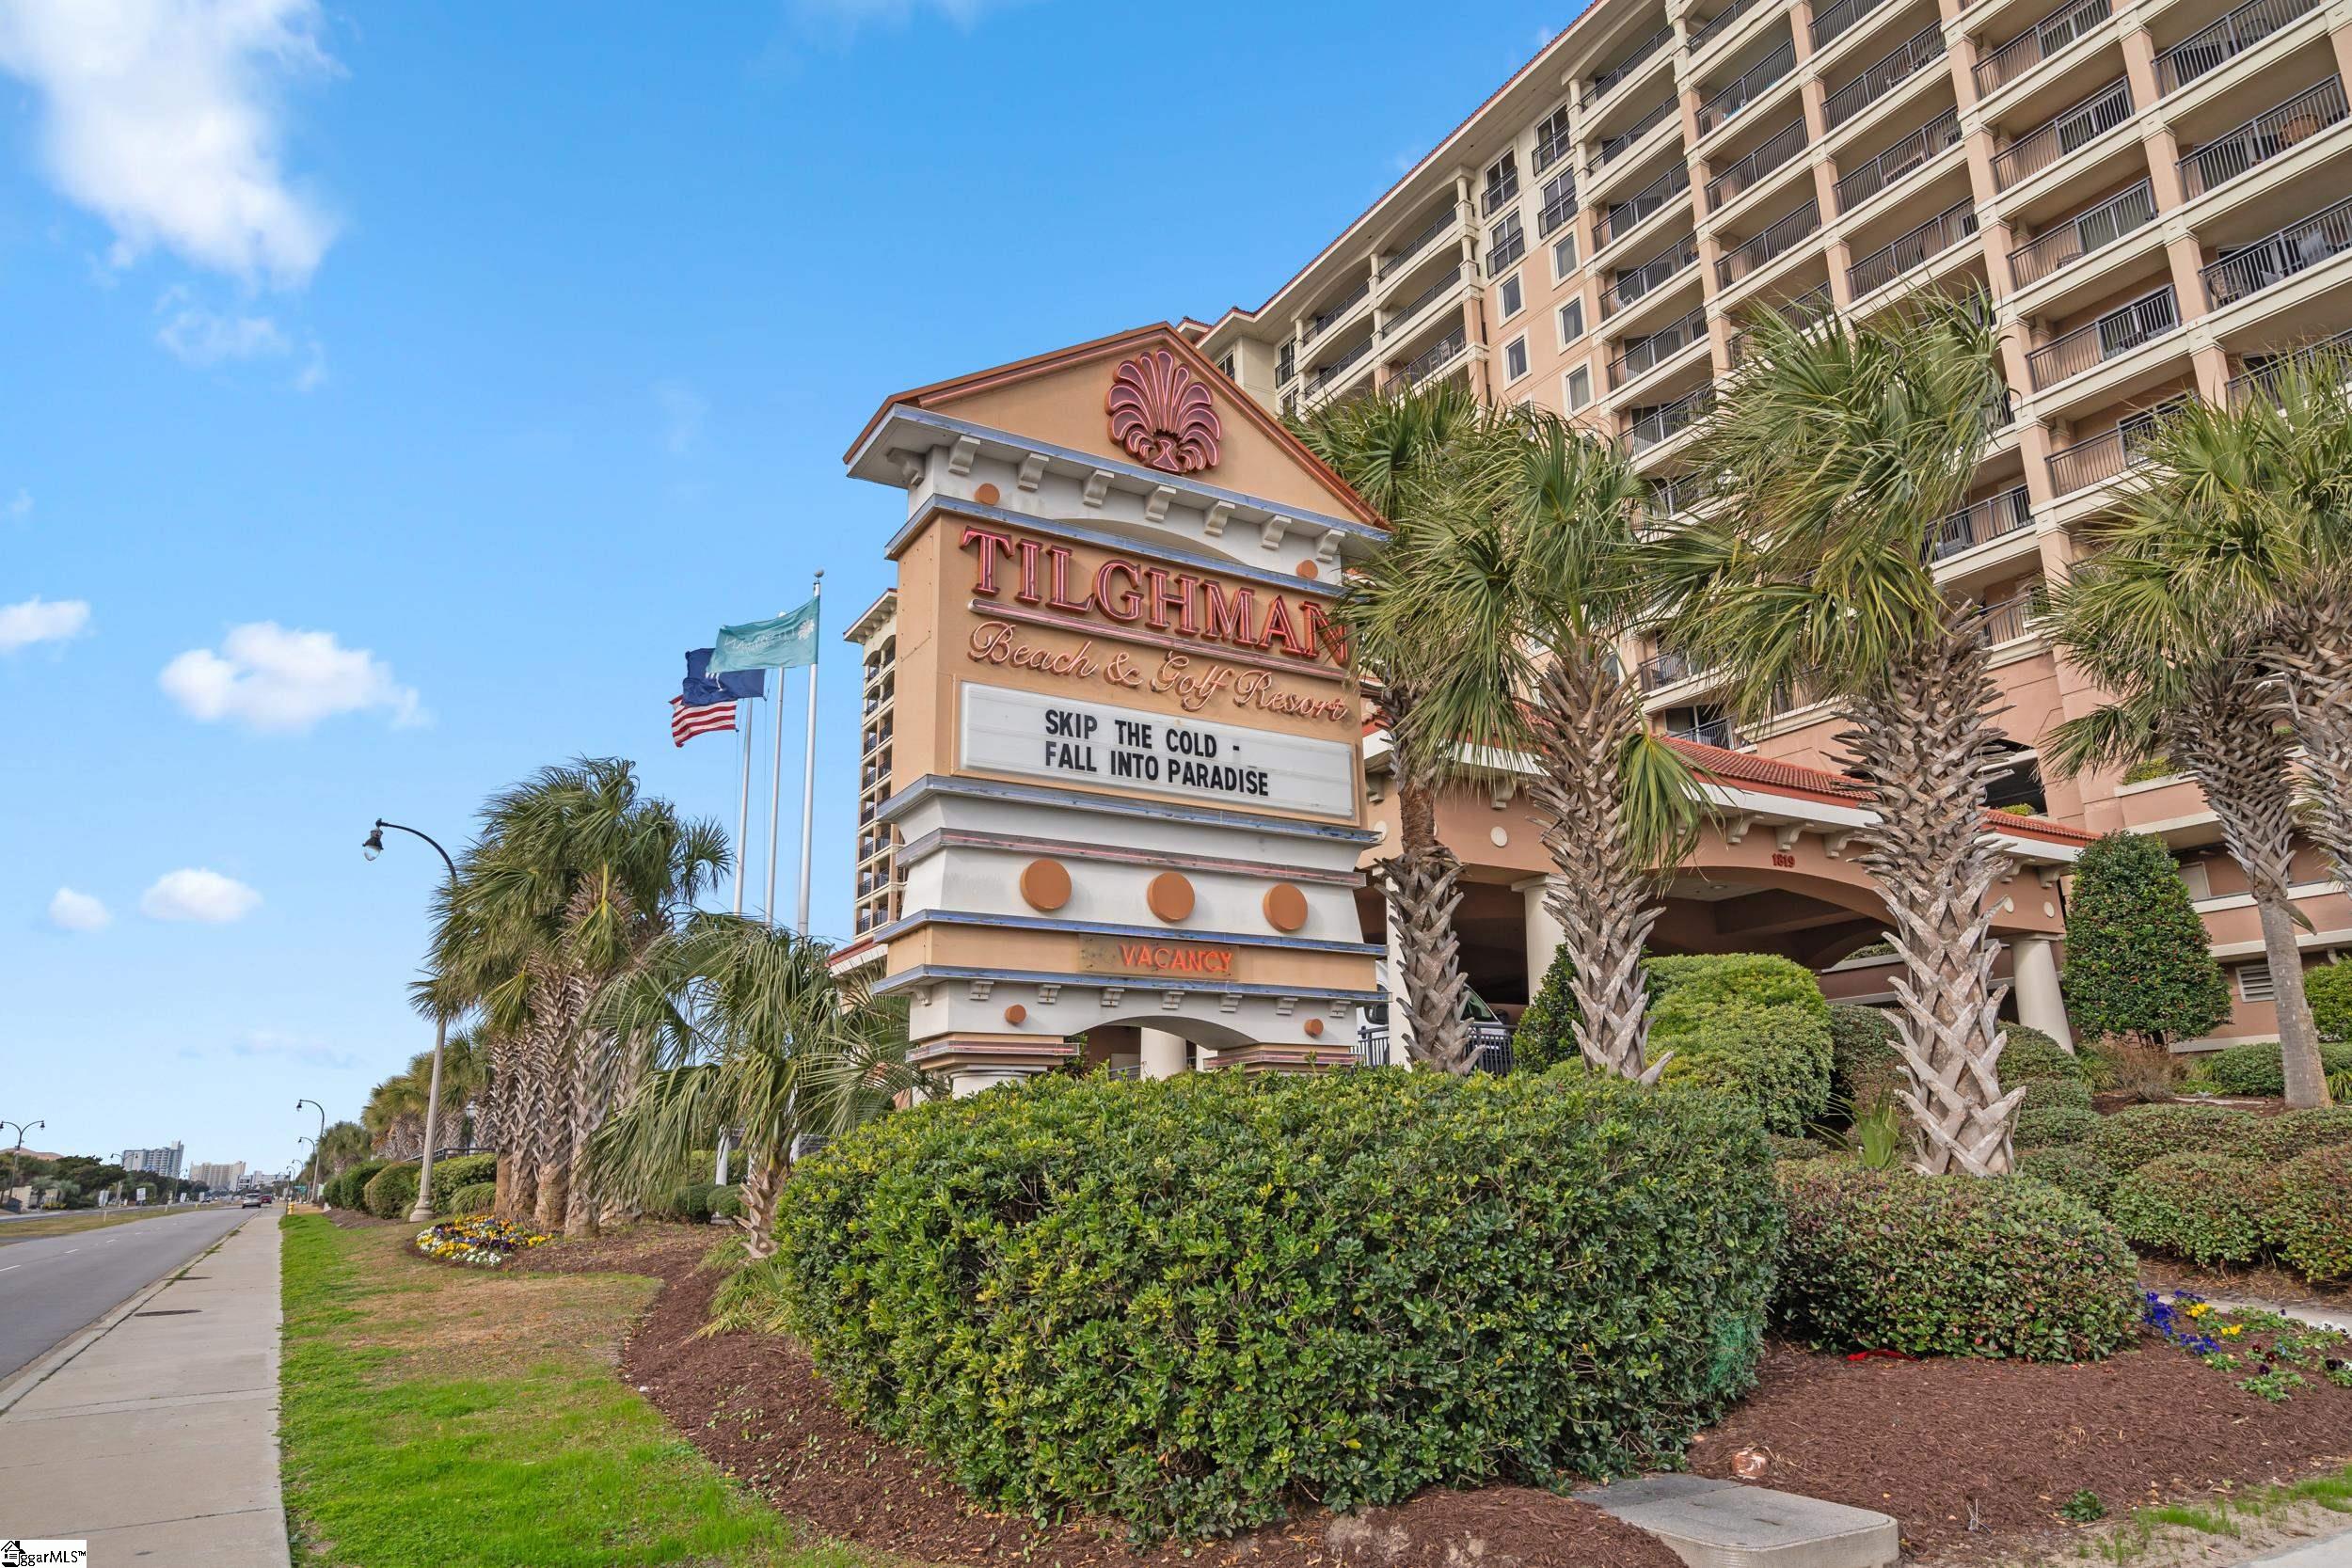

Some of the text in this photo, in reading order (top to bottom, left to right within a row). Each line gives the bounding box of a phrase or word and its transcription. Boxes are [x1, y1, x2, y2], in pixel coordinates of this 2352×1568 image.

[960, 525, 1348, 666] TILGHMAN
[968, 621, 1349, 722] Beach & Golf Resort
[1045, 709, 1098, 739] SKIP
[1115, 720, 1152, 749] THE
[1166, 728, 1217, 758] COLD
[1045, 740, 1268, 796] FALL INTO PARADISE
[1119, 944, 1232, 972] VACANCY
